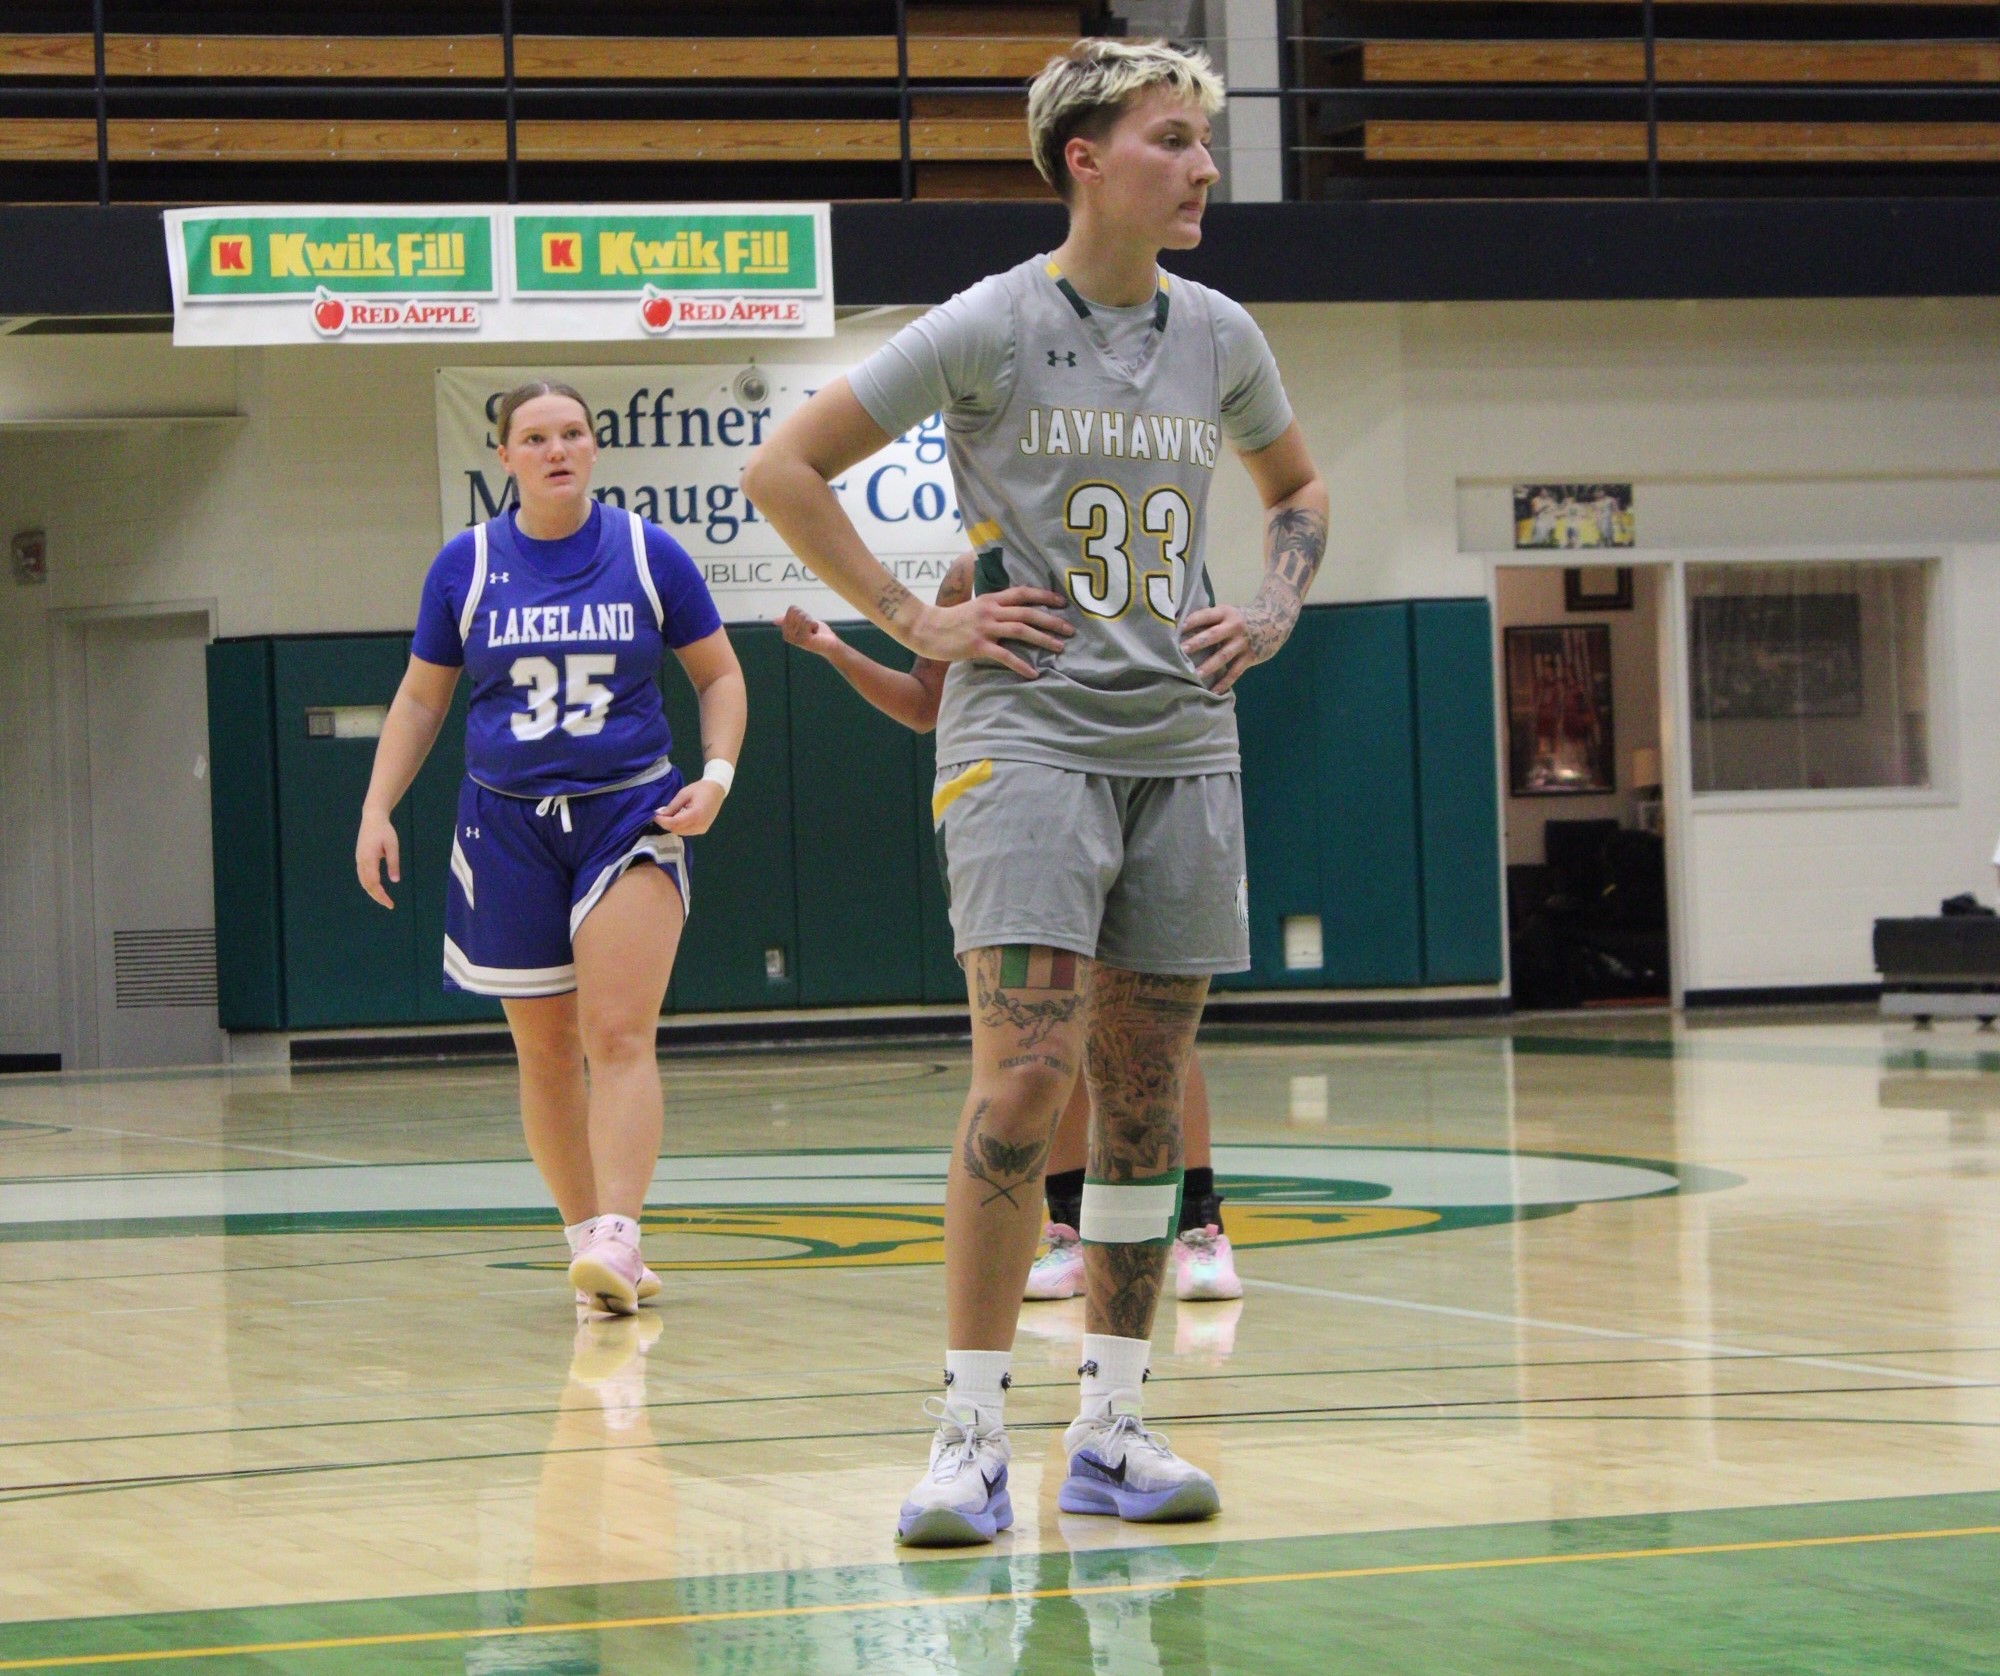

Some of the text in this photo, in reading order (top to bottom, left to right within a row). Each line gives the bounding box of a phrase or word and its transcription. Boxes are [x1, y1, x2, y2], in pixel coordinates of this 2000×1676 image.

[218, 241, 245, 270] K
[269, 233, 464, 277] Kwik Fill
[550, 239, 576, 267] K
[599, 231, 788, 275] Kwik Fill
[351, 304, 475, 324] RED APPLE
[679, 301, 800, 321] RED APPLE
[1019, 408, 1217, 469] JAYHAWKS
[1064, 478, 1193, 625] 33
[487, 603, 635, 648] LAKELAND
[509, 653, 617, 741] 35
